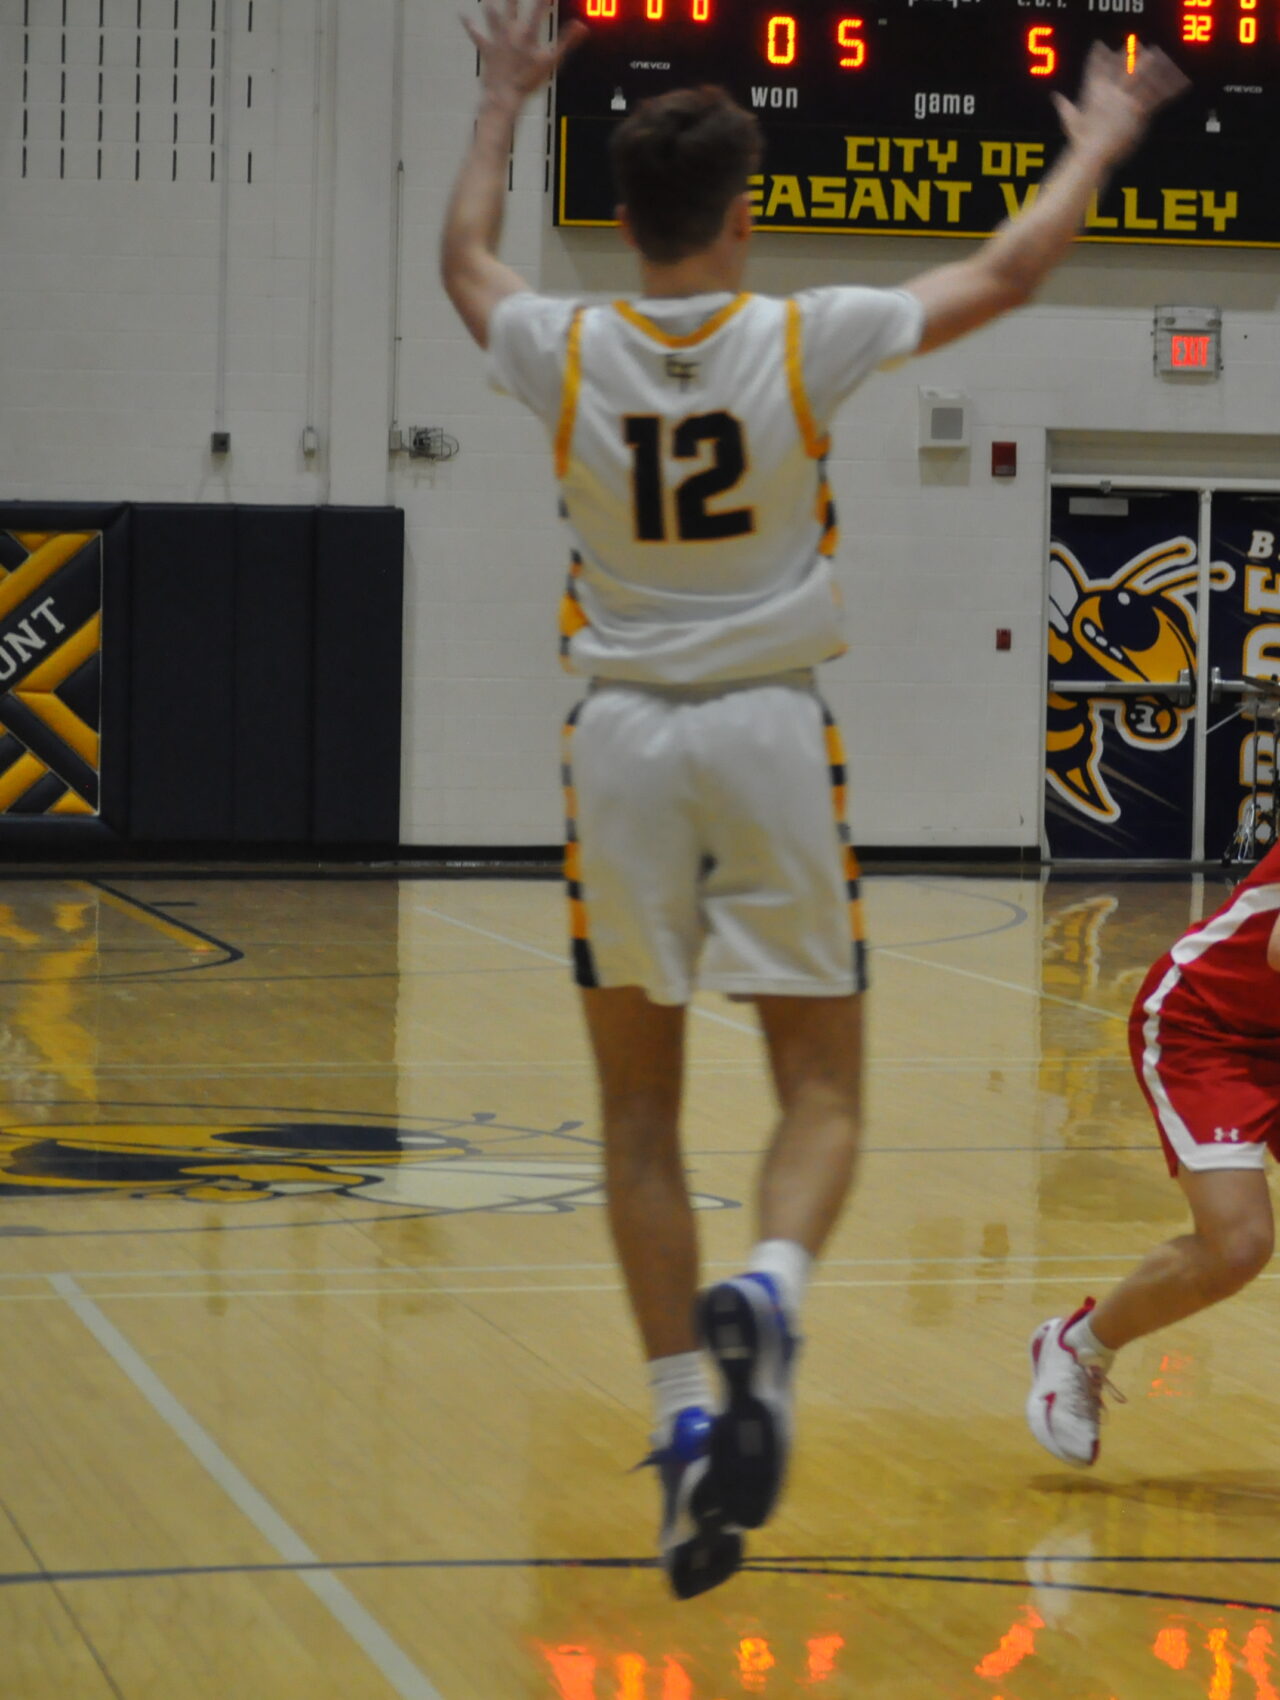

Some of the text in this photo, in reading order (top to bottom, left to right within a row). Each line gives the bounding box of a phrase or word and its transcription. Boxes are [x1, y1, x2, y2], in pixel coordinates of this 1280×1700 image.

[767, 16, 796, 64] 0
[837, 19, 865, 67] 5
[1027, 26, 1056, 75] 5
[1182, 14, 1213, 42] 32
[1239, 16, 1257, 44] 0
[751, 86, 799, 109] won
[914, 92, 976, 120] game
[844, 135, 1046, 178] CITY OF
[998, 183, 1238, 232] VLLEY
[1171, 334, 1211, 368] EXIT
[621, 409, 757, 544] 12
